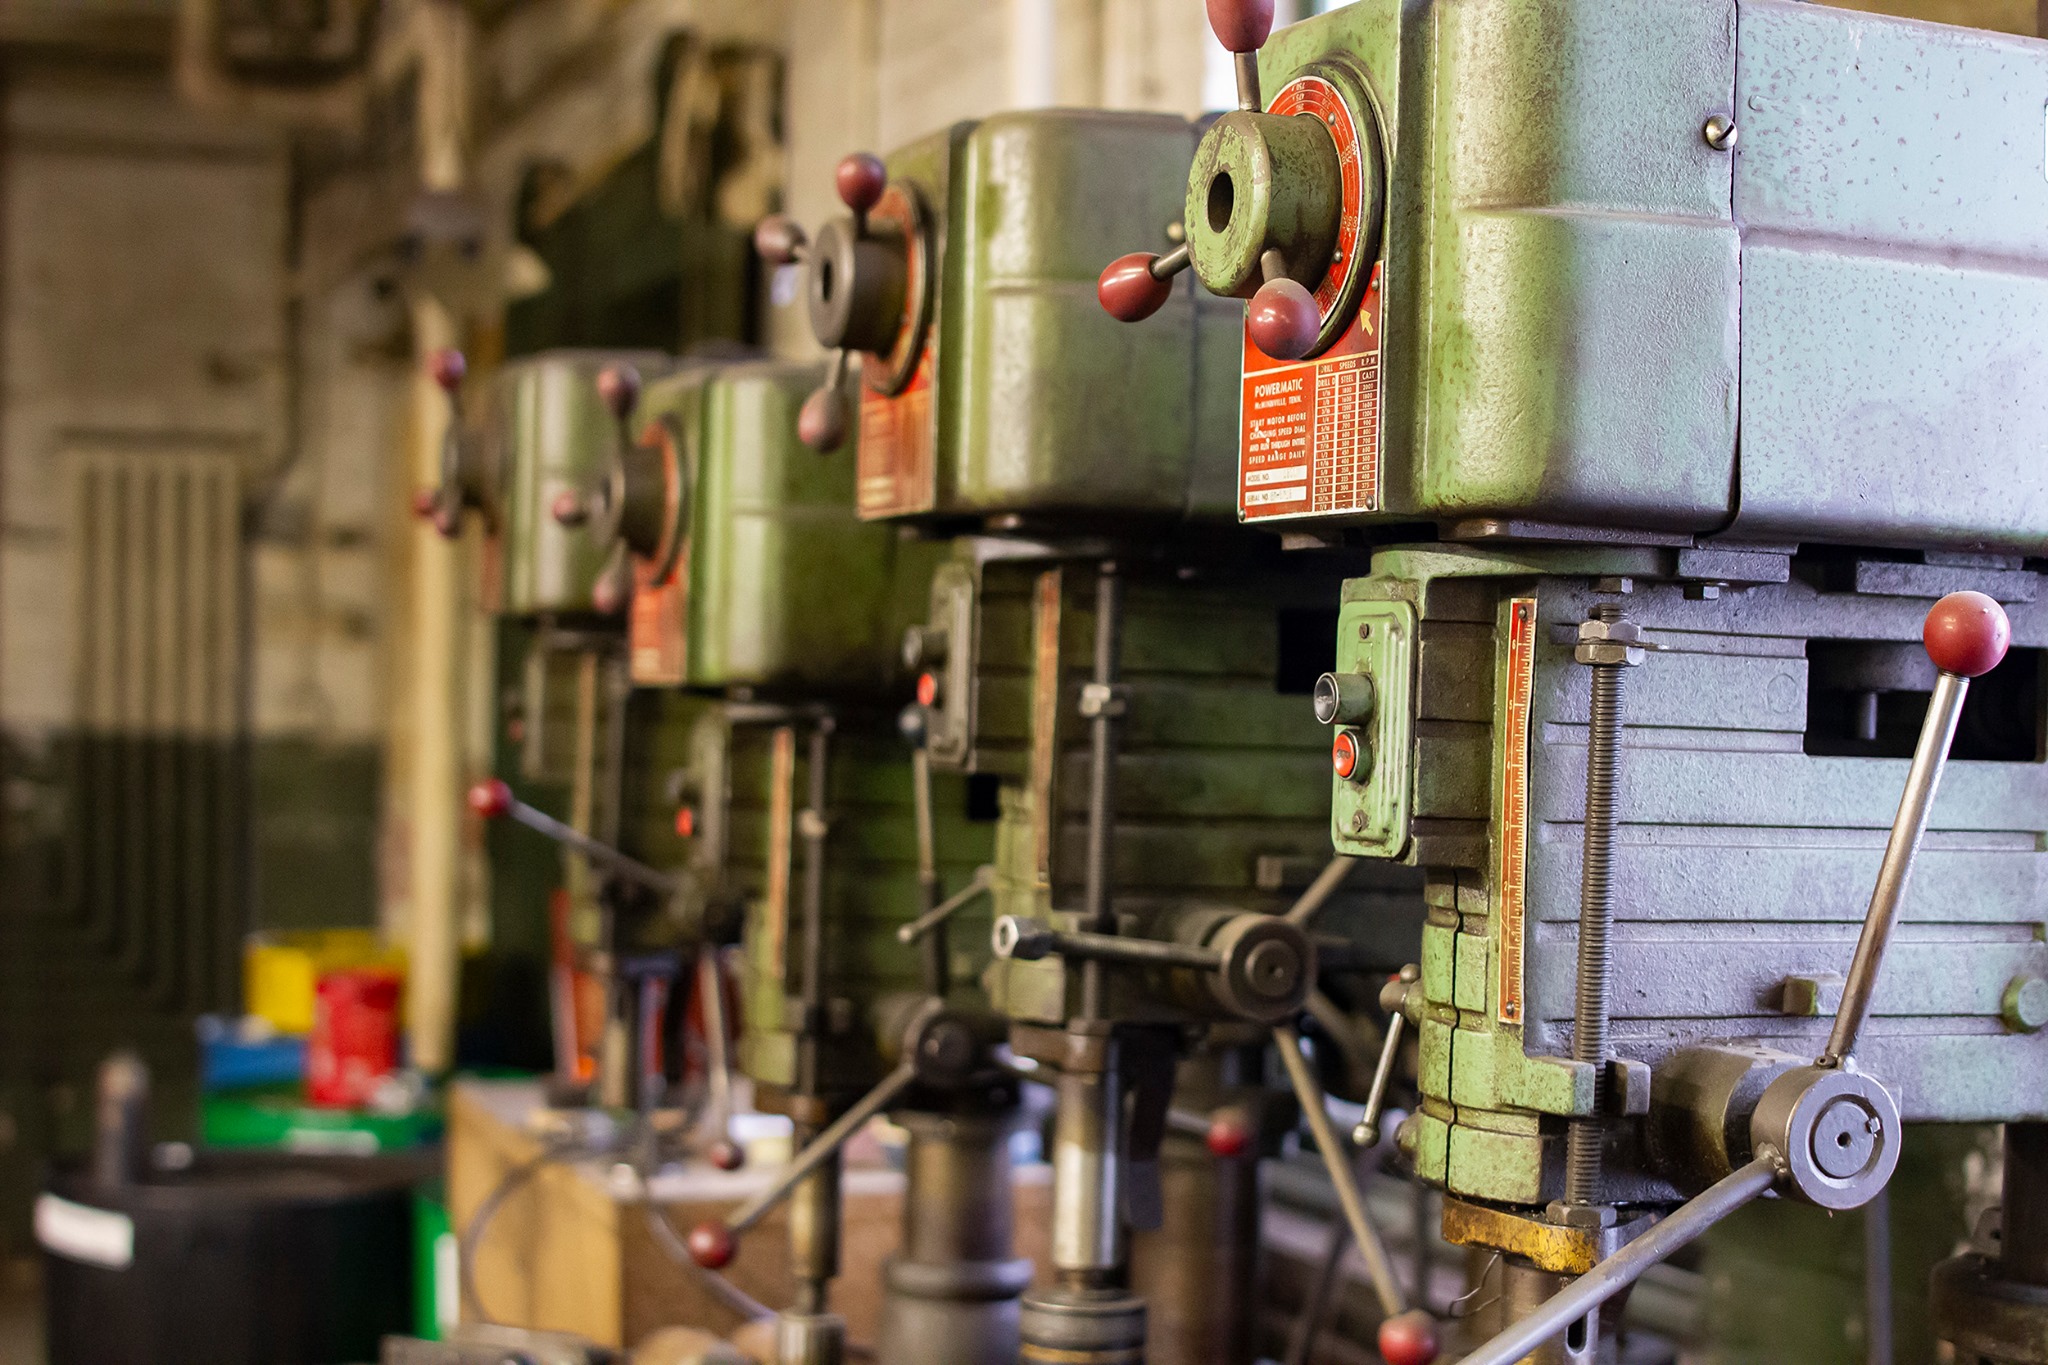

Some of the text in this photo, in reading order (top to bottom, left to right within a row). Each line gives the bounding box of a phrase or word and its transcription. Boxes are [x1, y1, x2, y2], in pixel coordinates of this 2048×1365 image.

[1339, 360, 1356, 370] SPEEDS
[1341, 375, 1354, 384] STEEL
[1362, 371, 1375, 380] CAST
[1255, 378, 1303, 398] POWERMATIC
[1267, 416, 1285, 425] MOTOR
[1287, 412, 1306, 422] BEFORE
[1278, 427, 1292, 436] SPEED
[1294, 425, 1306, 434] DIAL
[1249, 450, 1305, 465] SPEED RANGE DAILY
[1512, 639, 1516, 650] 6
[1509, 699, 1513, 710] 5
[1503, 881, 1508, 891] 2
